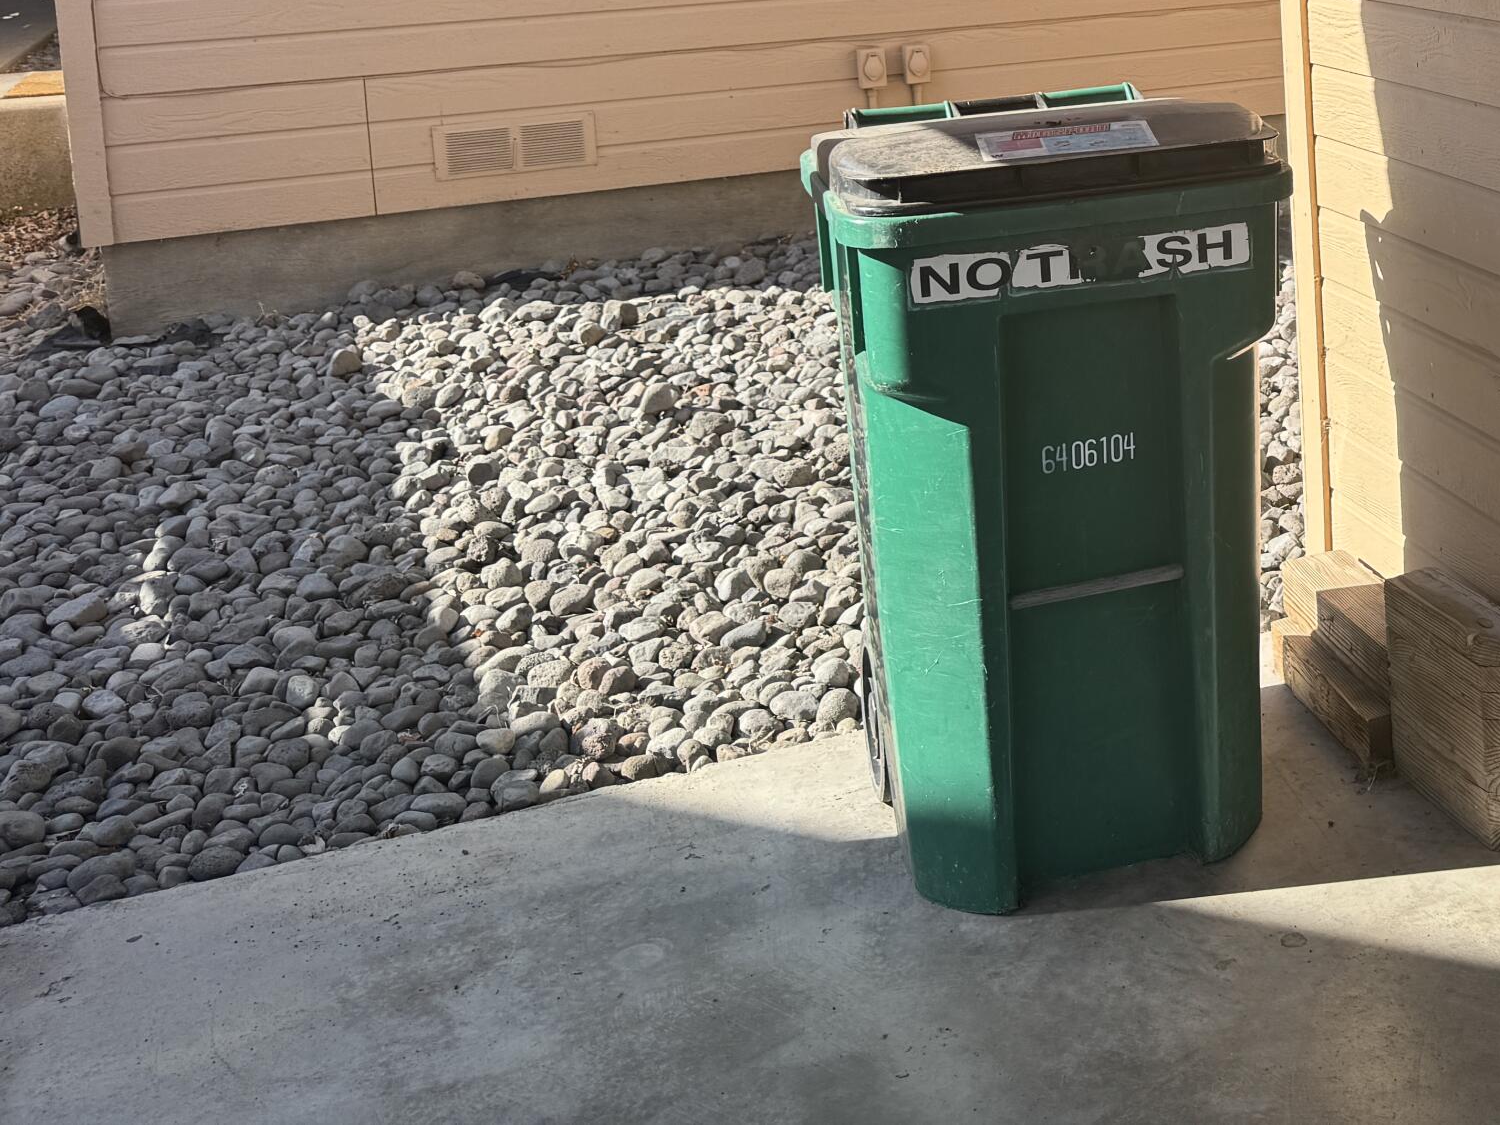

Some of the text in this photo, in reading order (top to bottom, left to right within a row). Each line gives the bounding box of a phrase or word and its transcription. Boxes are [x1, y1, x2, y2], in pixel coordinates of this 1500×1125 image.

[919, 230, 1233, 299] NO TSH
[1041, 432, 1136, 474] 6406104
